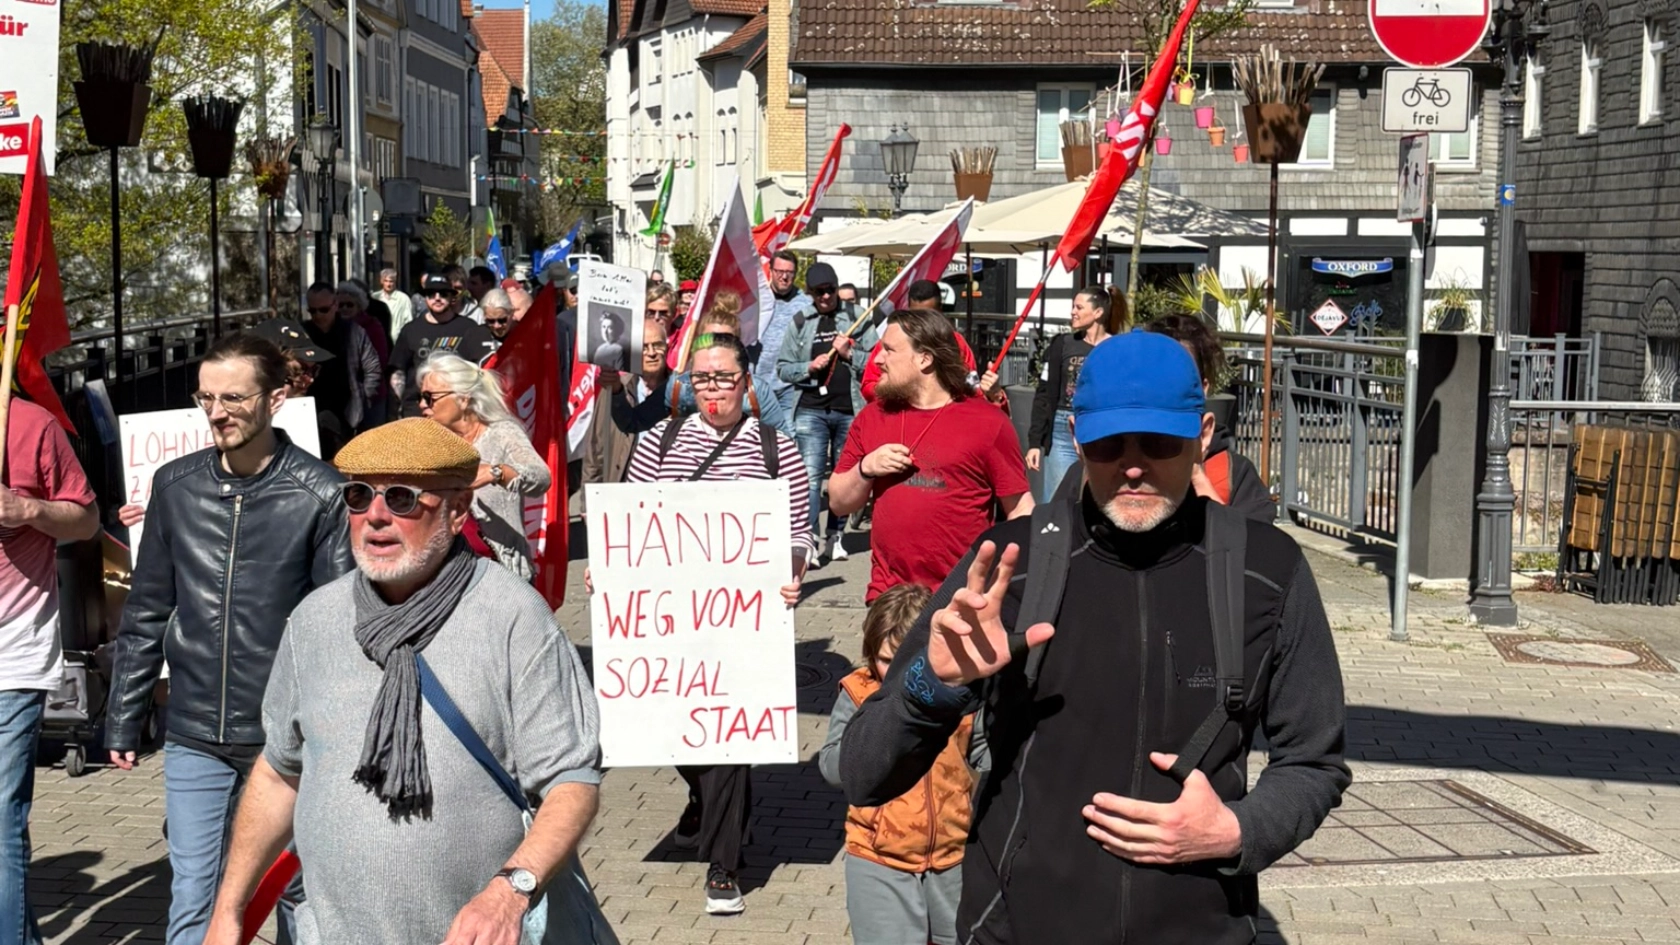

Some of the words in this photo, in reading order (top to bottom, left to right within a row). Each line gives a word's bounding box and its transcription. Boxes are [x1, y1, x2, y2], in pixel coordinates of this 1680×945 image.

[1412, 111, 1439, 125] frei
[1327, 261, 1378, 271] OXFORD
[604, 501, 771, 568] HÄNDE
[604, 589, 674, 639] WEG
[692, 587, 763, 631] VOM
[600, 656, 729, 699] SOZIAL
[682, 706, 796, 748] STAAT
